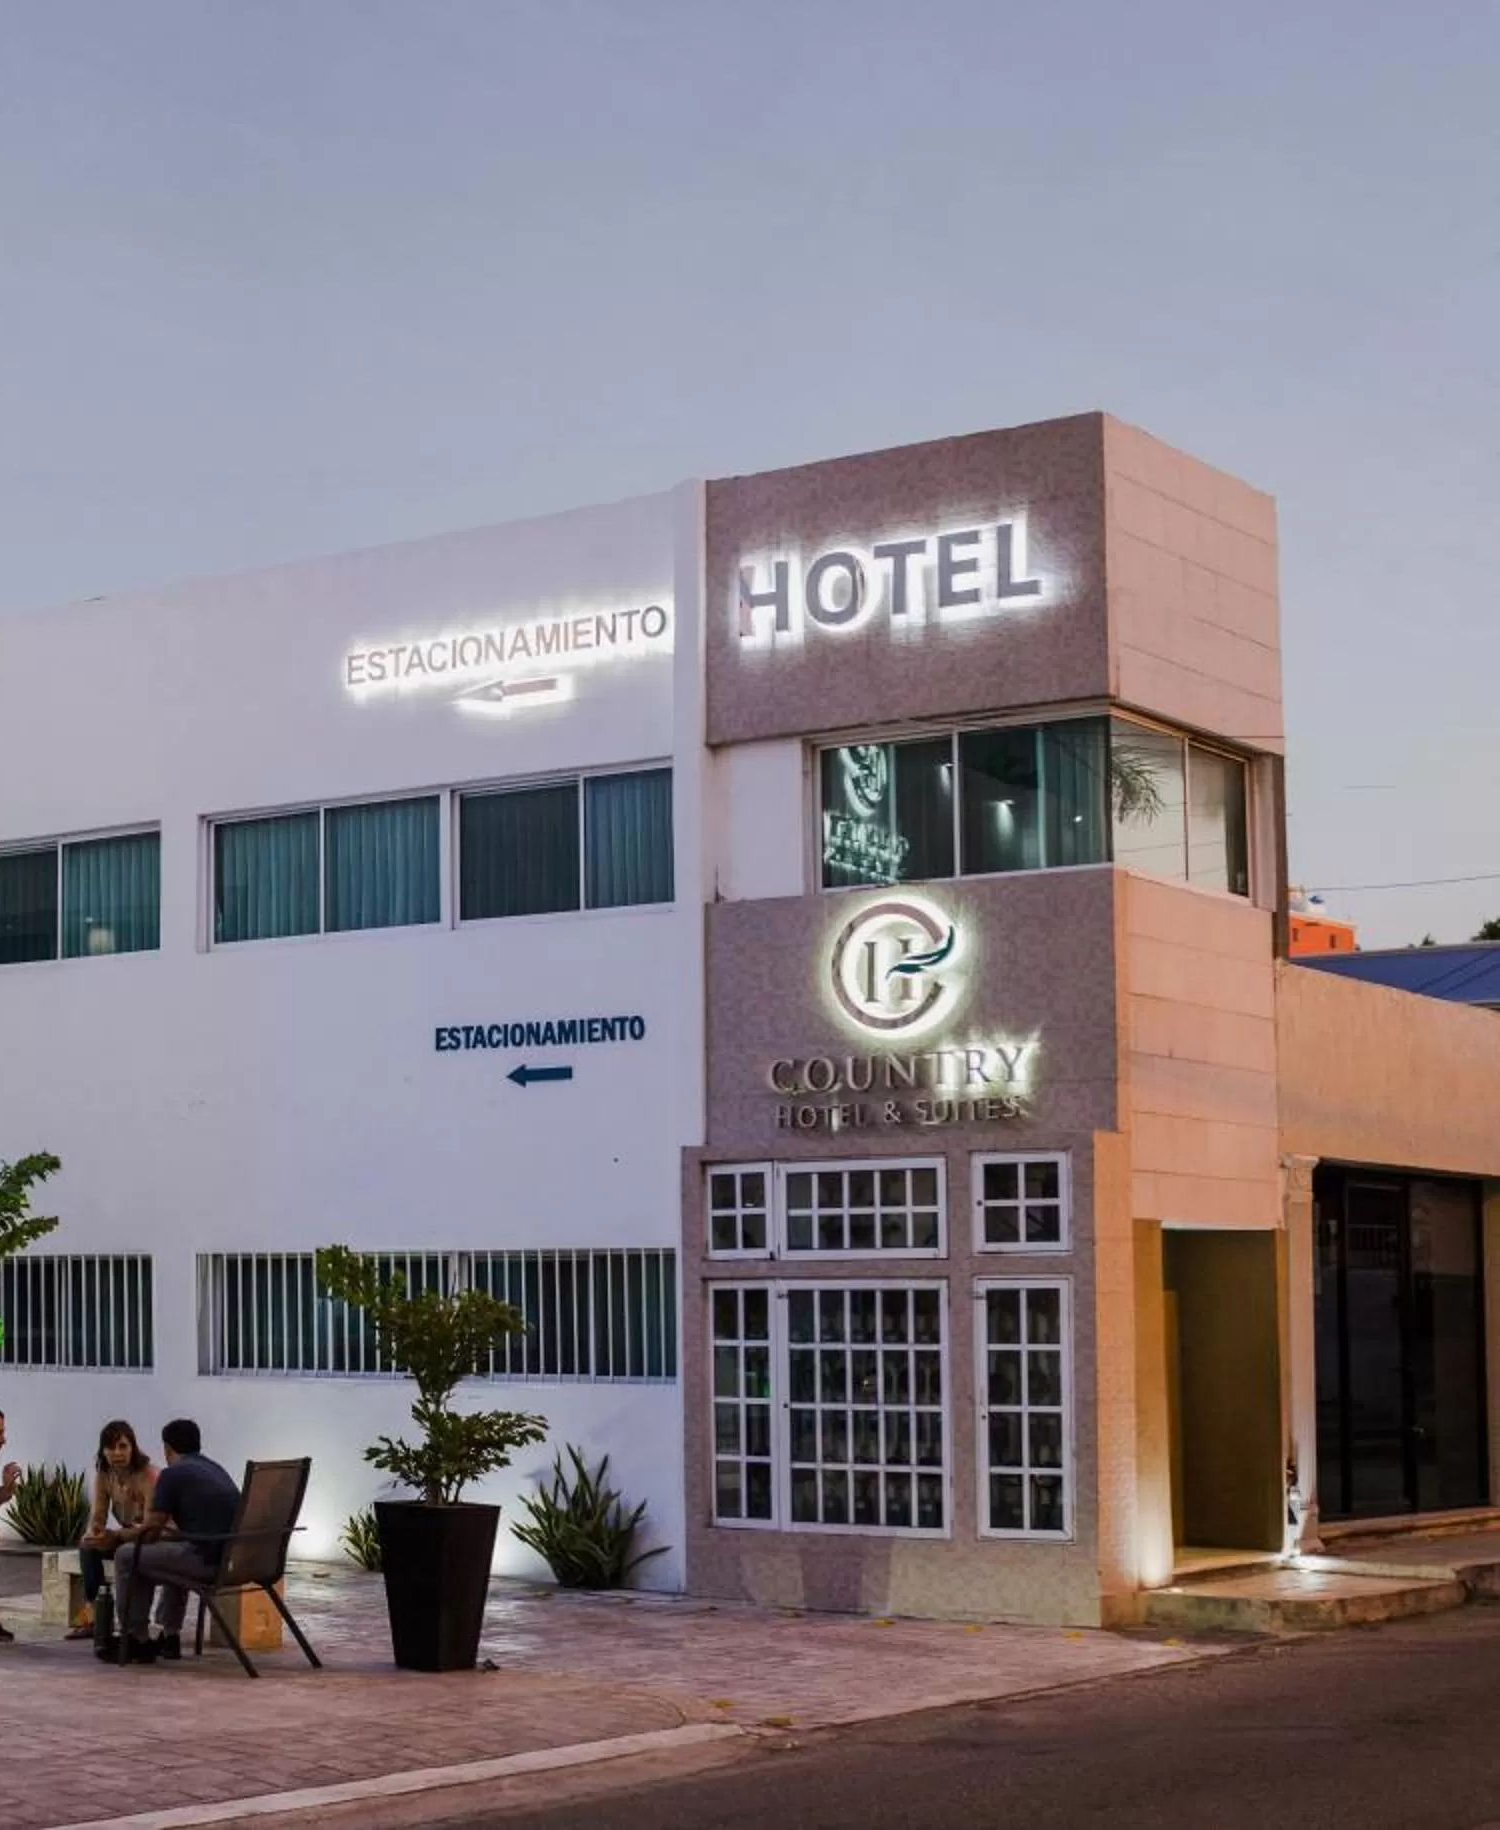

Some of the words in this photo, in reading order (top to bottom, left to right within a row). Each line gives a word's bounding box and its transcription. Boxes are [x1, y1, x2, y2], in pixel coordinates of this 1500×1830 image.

[739, 522, 1041, 638] HOTEL
[346, 605, 668, 685] ESTACIONAMIENTO
[435, 1015, 646, 1051] ESTACIONAMIENTO
[768, 1046, 1028, 1094] COUNTRY
[775, 1102, 867, 1130] HOTEL
[884, 1099, 900, 1123] &
[915, 1096, 1025, 1125] SUITES
